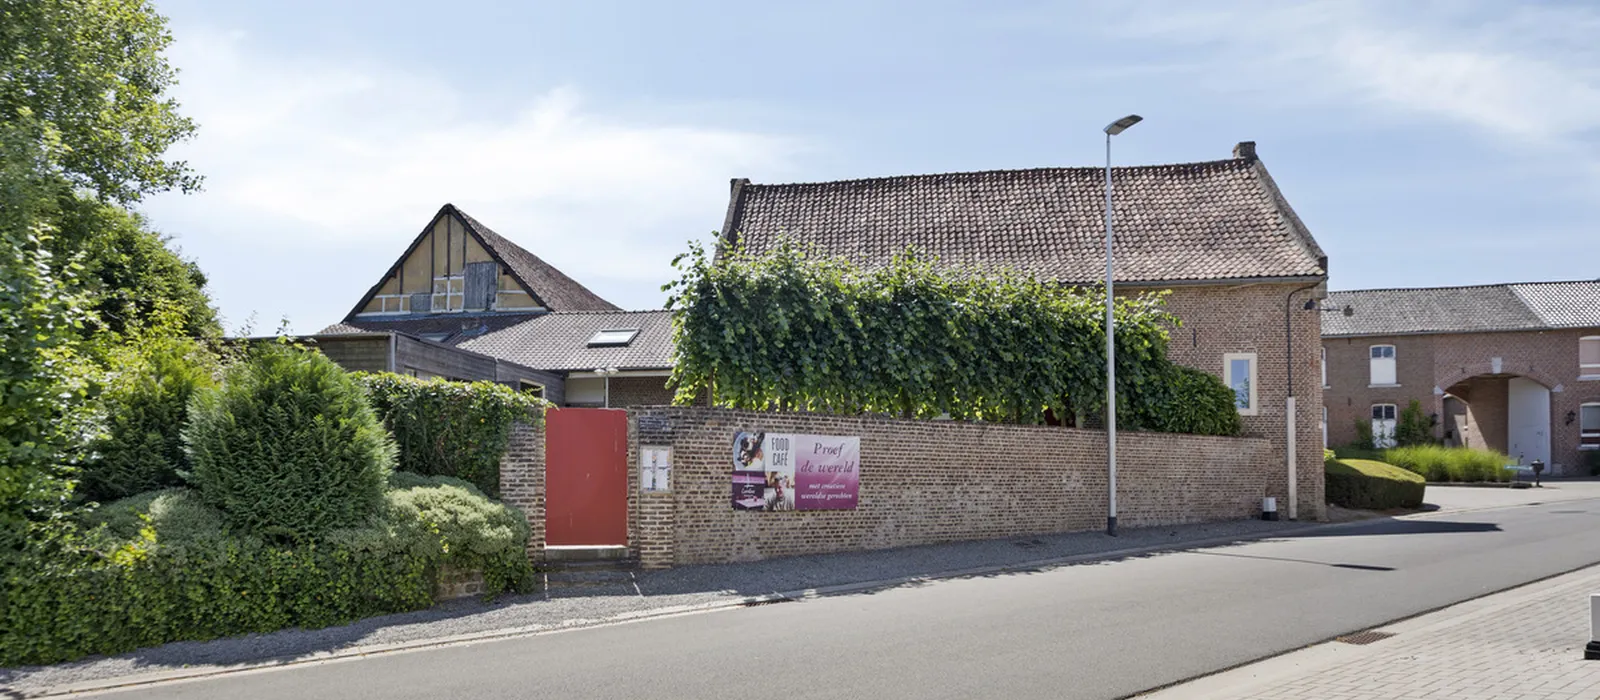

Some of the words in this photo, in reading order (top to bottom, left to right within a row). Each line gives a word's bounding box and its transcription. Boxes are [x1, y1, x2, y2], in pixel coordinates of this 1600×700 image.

[771, 437, 790, 451] FOOD
[813, 442, 846, 458] Proef
[772, 452, 789, 466] CAFÉ
[800, 460, 814, 473] de
[818, 460, 854, 473] wereld
